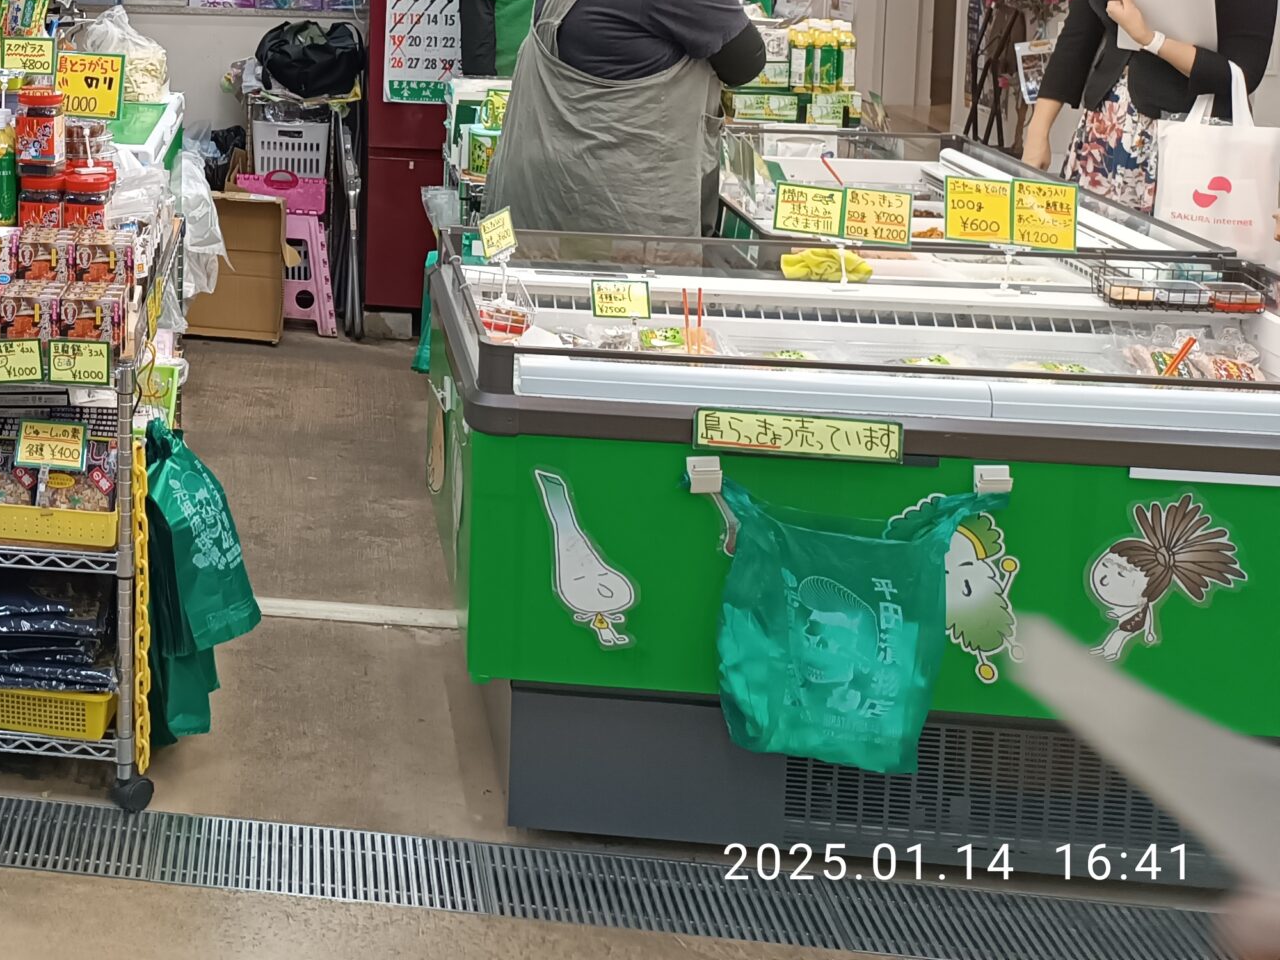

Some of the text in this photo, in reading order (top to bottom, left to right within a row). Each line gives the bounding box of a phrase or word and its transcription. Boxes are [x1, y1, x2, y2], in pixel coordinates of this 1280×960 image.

[393, 13, 455, 26] 12 13 14 15
[391, 35, 455, 48] 19 20 21 22
[5, 43, 46, 54] スクガラス
[21, 59, 50, 71] ¥800
[57, 56, 119, 74] 島とうがらし
[391, 57, 454, 70] 26 27 28 29
[84, 76, 114, 91] のり
[781, 188, 808, 202] 機内
[849, 191, 904, 208] 島らっきょう
[951, 199, 984, 212] 100g
[847, 211, 905, 224] 50g ¥700
[959, 215, 1001, 233] ¥600
[1017, 214, 1073, 228] あぐーソーセージ
[1170, 211, 1253, 227] SAKURA internet
[846, 225, 868, 237] 100g
[597, 304, 627, 315] ¥2500
[700, 412, 900, 461] 島らっきょう売っています。
[25, 443, 80, 460] 各種 ¥400
